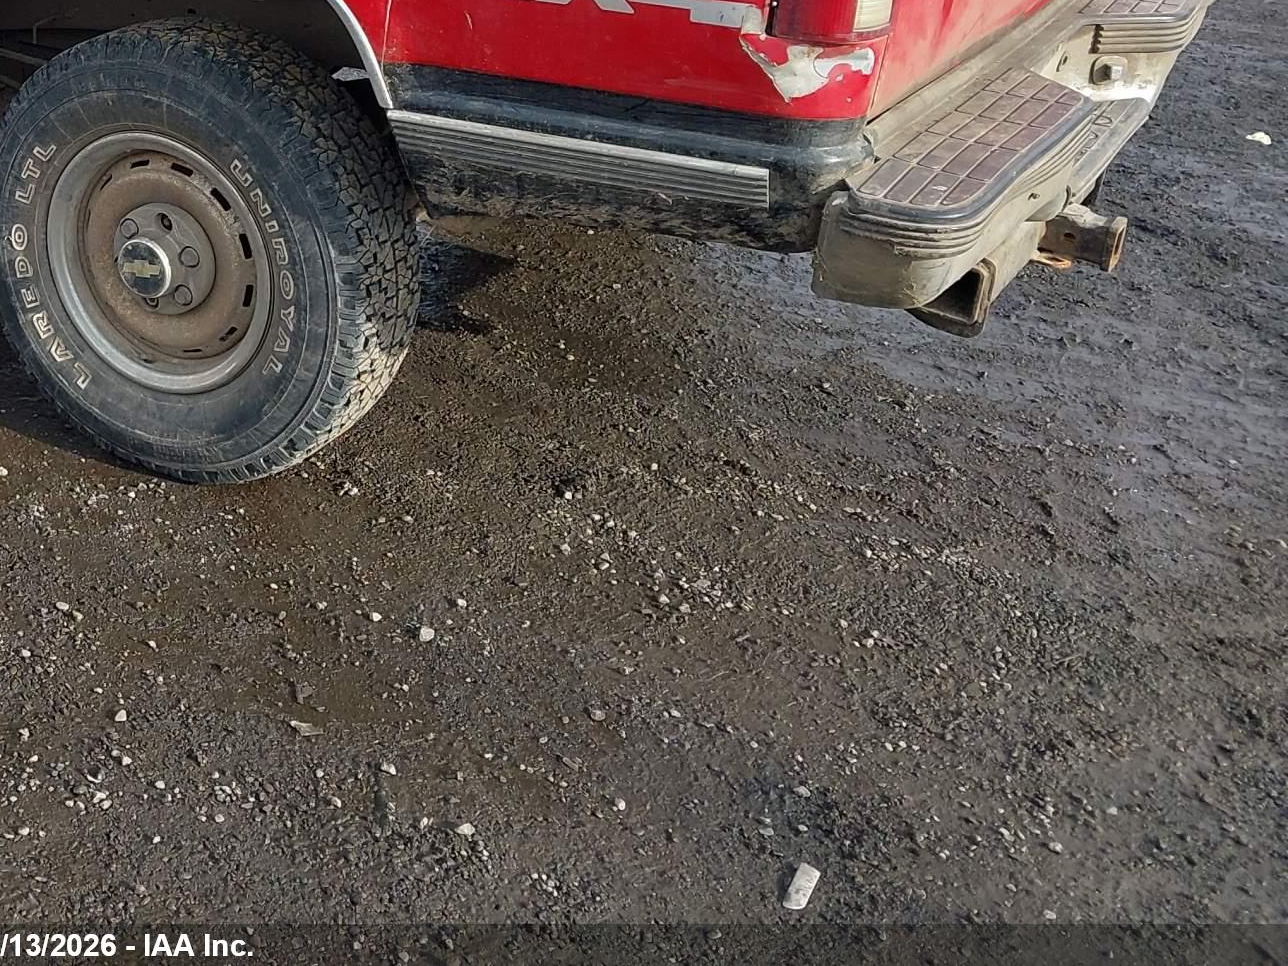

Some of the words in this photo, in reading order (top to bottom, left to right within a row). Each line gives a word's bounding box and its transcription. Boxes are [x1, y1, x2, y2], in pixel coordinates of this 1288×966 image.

[14, 142, 57, 205] LTL
[10, 222, 93, 391] LAREDO
[229, 158, 296, 376] UNIROYAL
